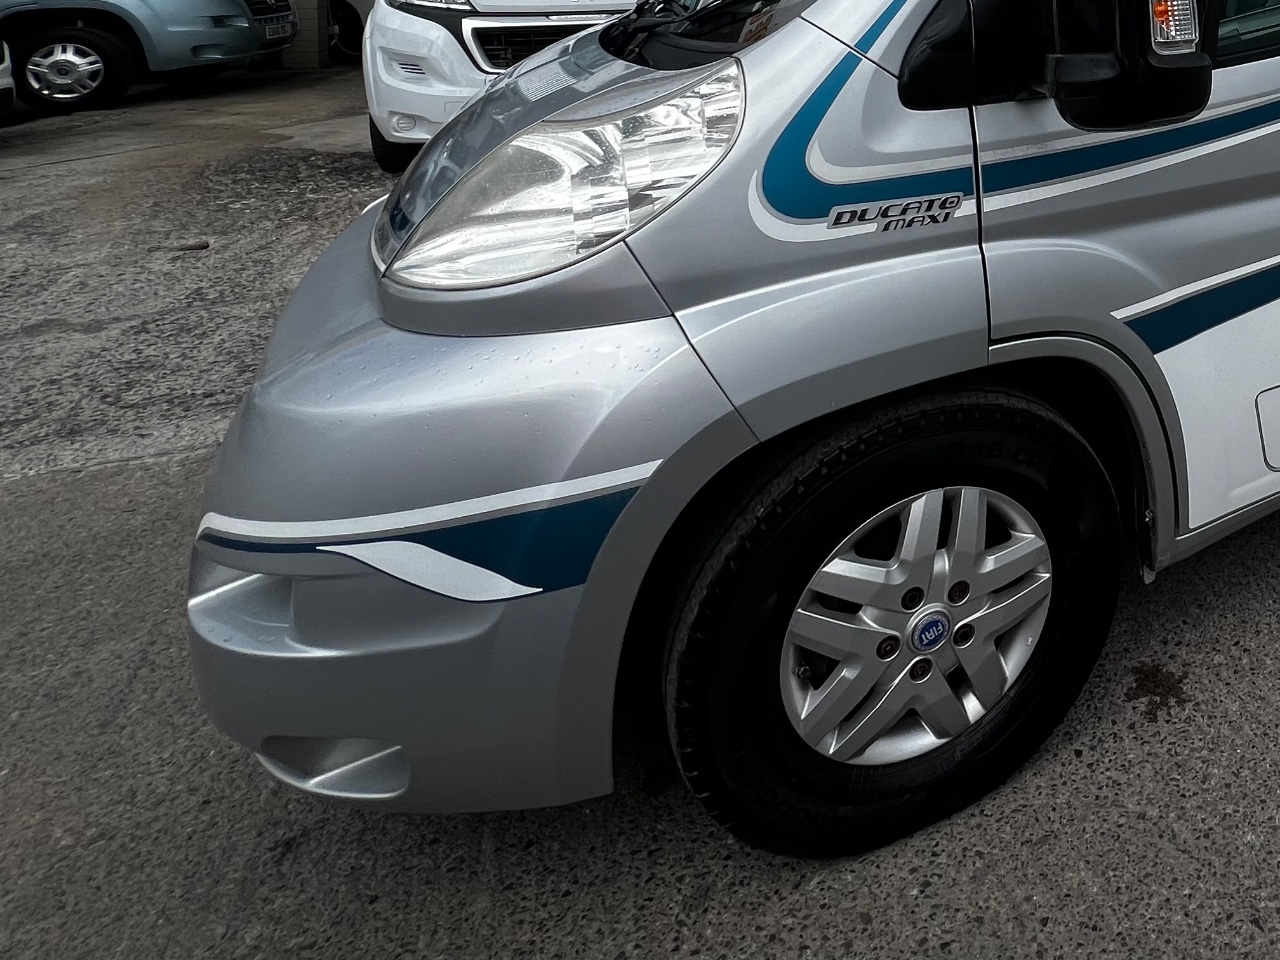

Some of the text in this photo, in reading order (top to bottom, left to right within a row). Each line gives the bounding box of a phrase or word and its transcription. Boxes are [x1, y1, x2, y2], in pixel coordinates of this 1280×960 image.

[832, 195, 961, 227] DUCATO
[881, 211, 950, 233] MAXI
[921, 622, 944, 645] FIAT
